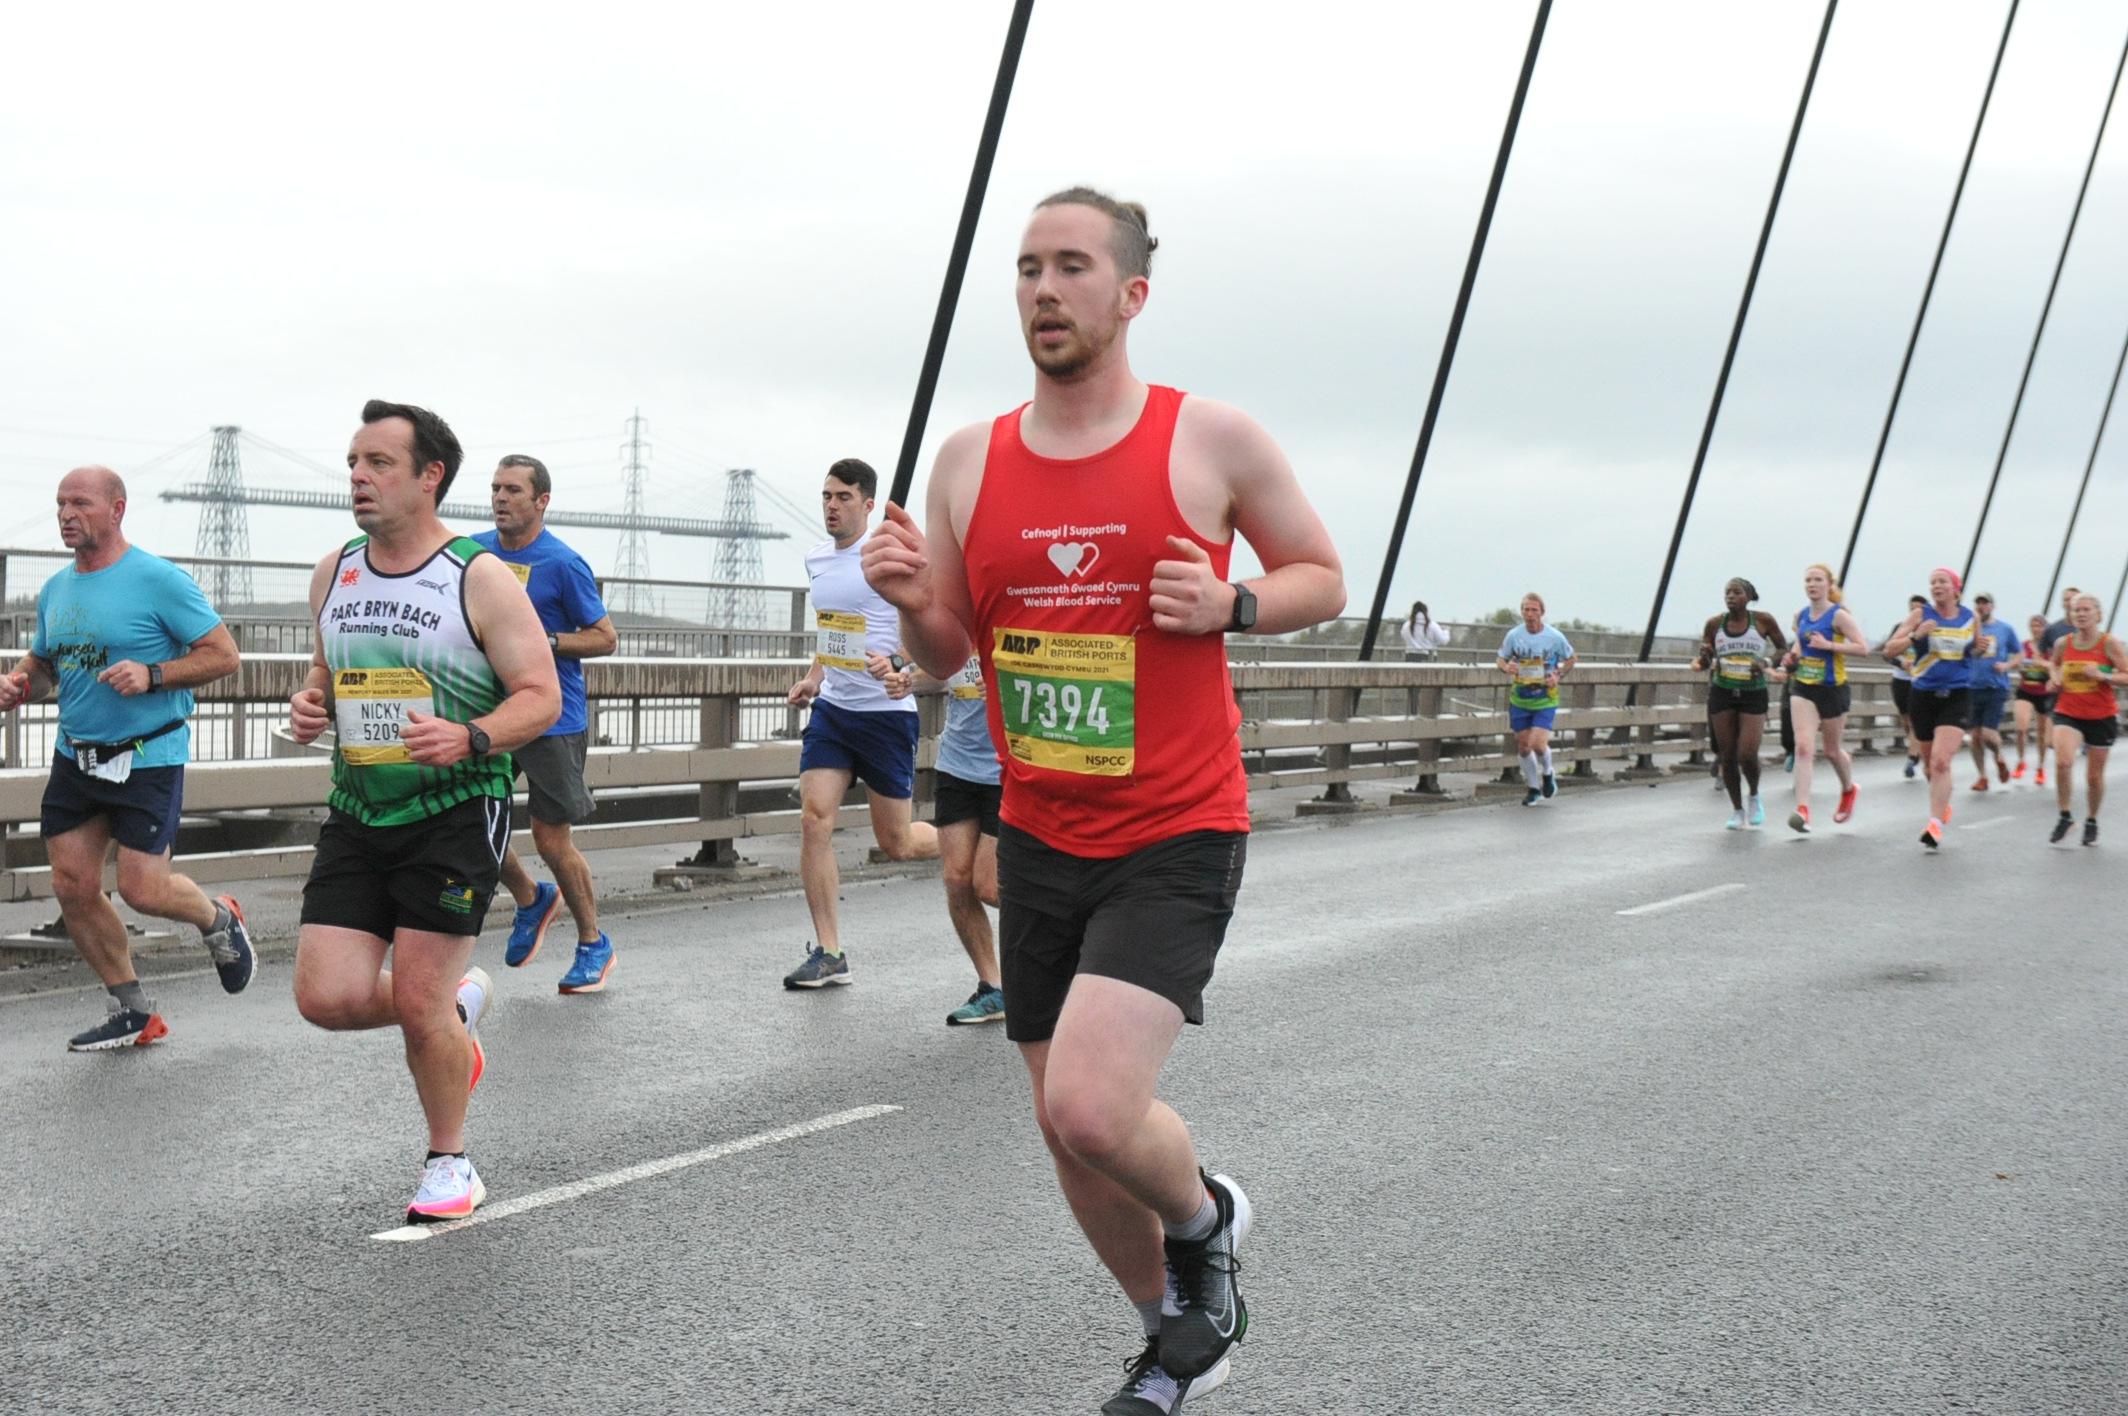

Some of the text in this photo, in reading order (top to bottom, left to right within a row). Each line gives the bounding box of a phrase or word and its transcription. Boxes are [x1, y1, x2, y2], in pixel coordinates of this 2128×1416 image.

[1021, 522, 1127, 539] Cefnogi Supporting
[1006, 581, 1140, 596] Gwasanaeth Gwaed Cymru
[1023, 594, 1122, 608] Welsh Blood Service
[330, 600, 441, 631] PARC BRYN BACH
[338, 621, 420, 640] Running Club
[828, 631, 847, 644] ROSS
[1000, 633, 1041, 656] ABP
[1050, 638, 1114, 650] ASSOCIATED
[1050, 648, 1127, 661] BRITISH PORTS
[339, 672, 368, 686] ABP
[361, 702, 401, 720] NICKY
[1013, 678, 1110, 735] 7394
[363, 722, 400, 741] 5209
[1085, 754, 1126, 767] NSPCC
